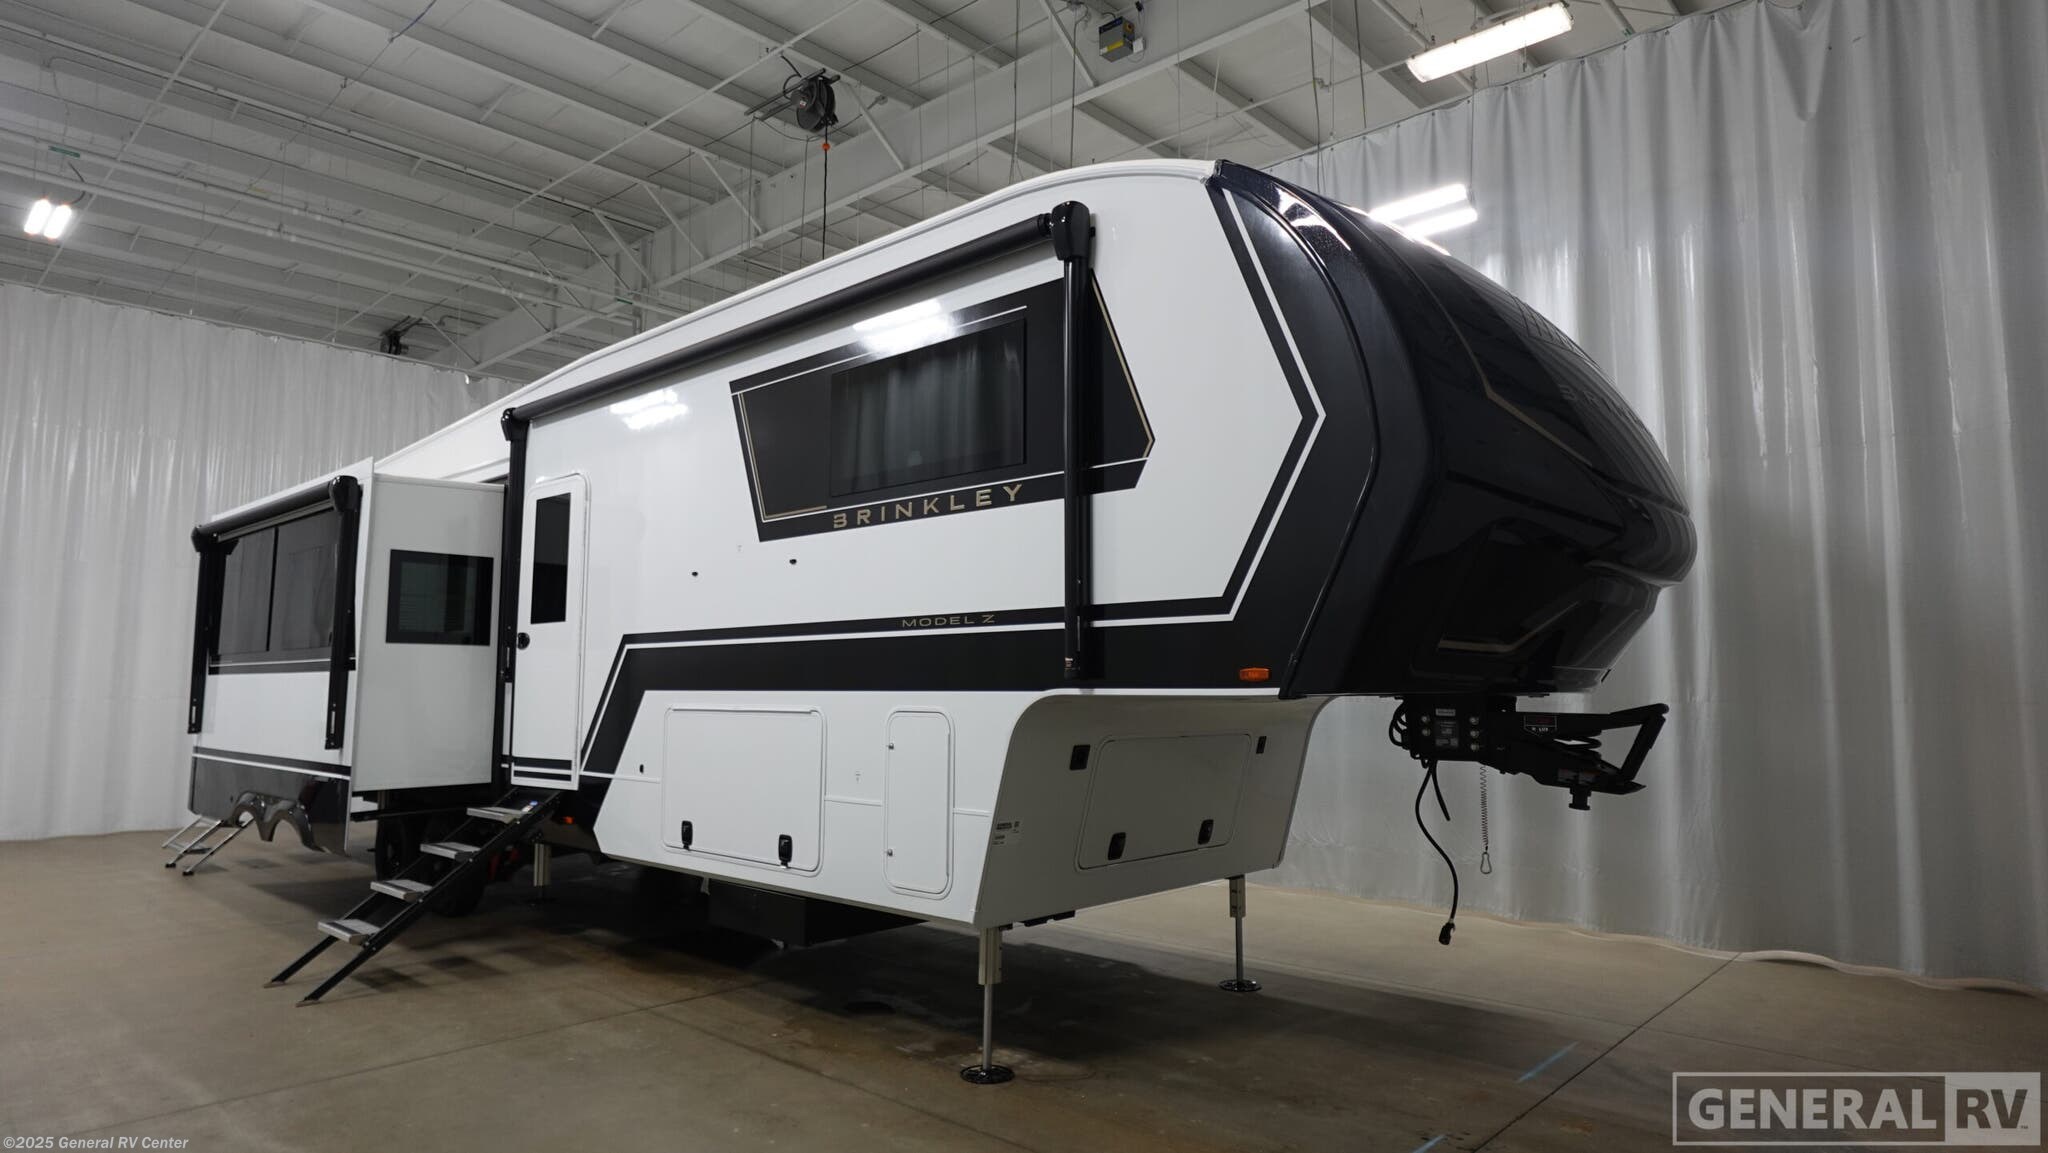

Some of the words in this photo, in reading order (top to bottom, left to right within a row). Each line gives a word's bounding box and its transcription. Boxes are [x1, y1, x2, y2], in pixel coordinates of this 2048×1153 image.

[833, 483, 1022, 529] BRINKLEY
[902, 615, 975, 627] MODEL
[981, 614, 995, 624] Z
